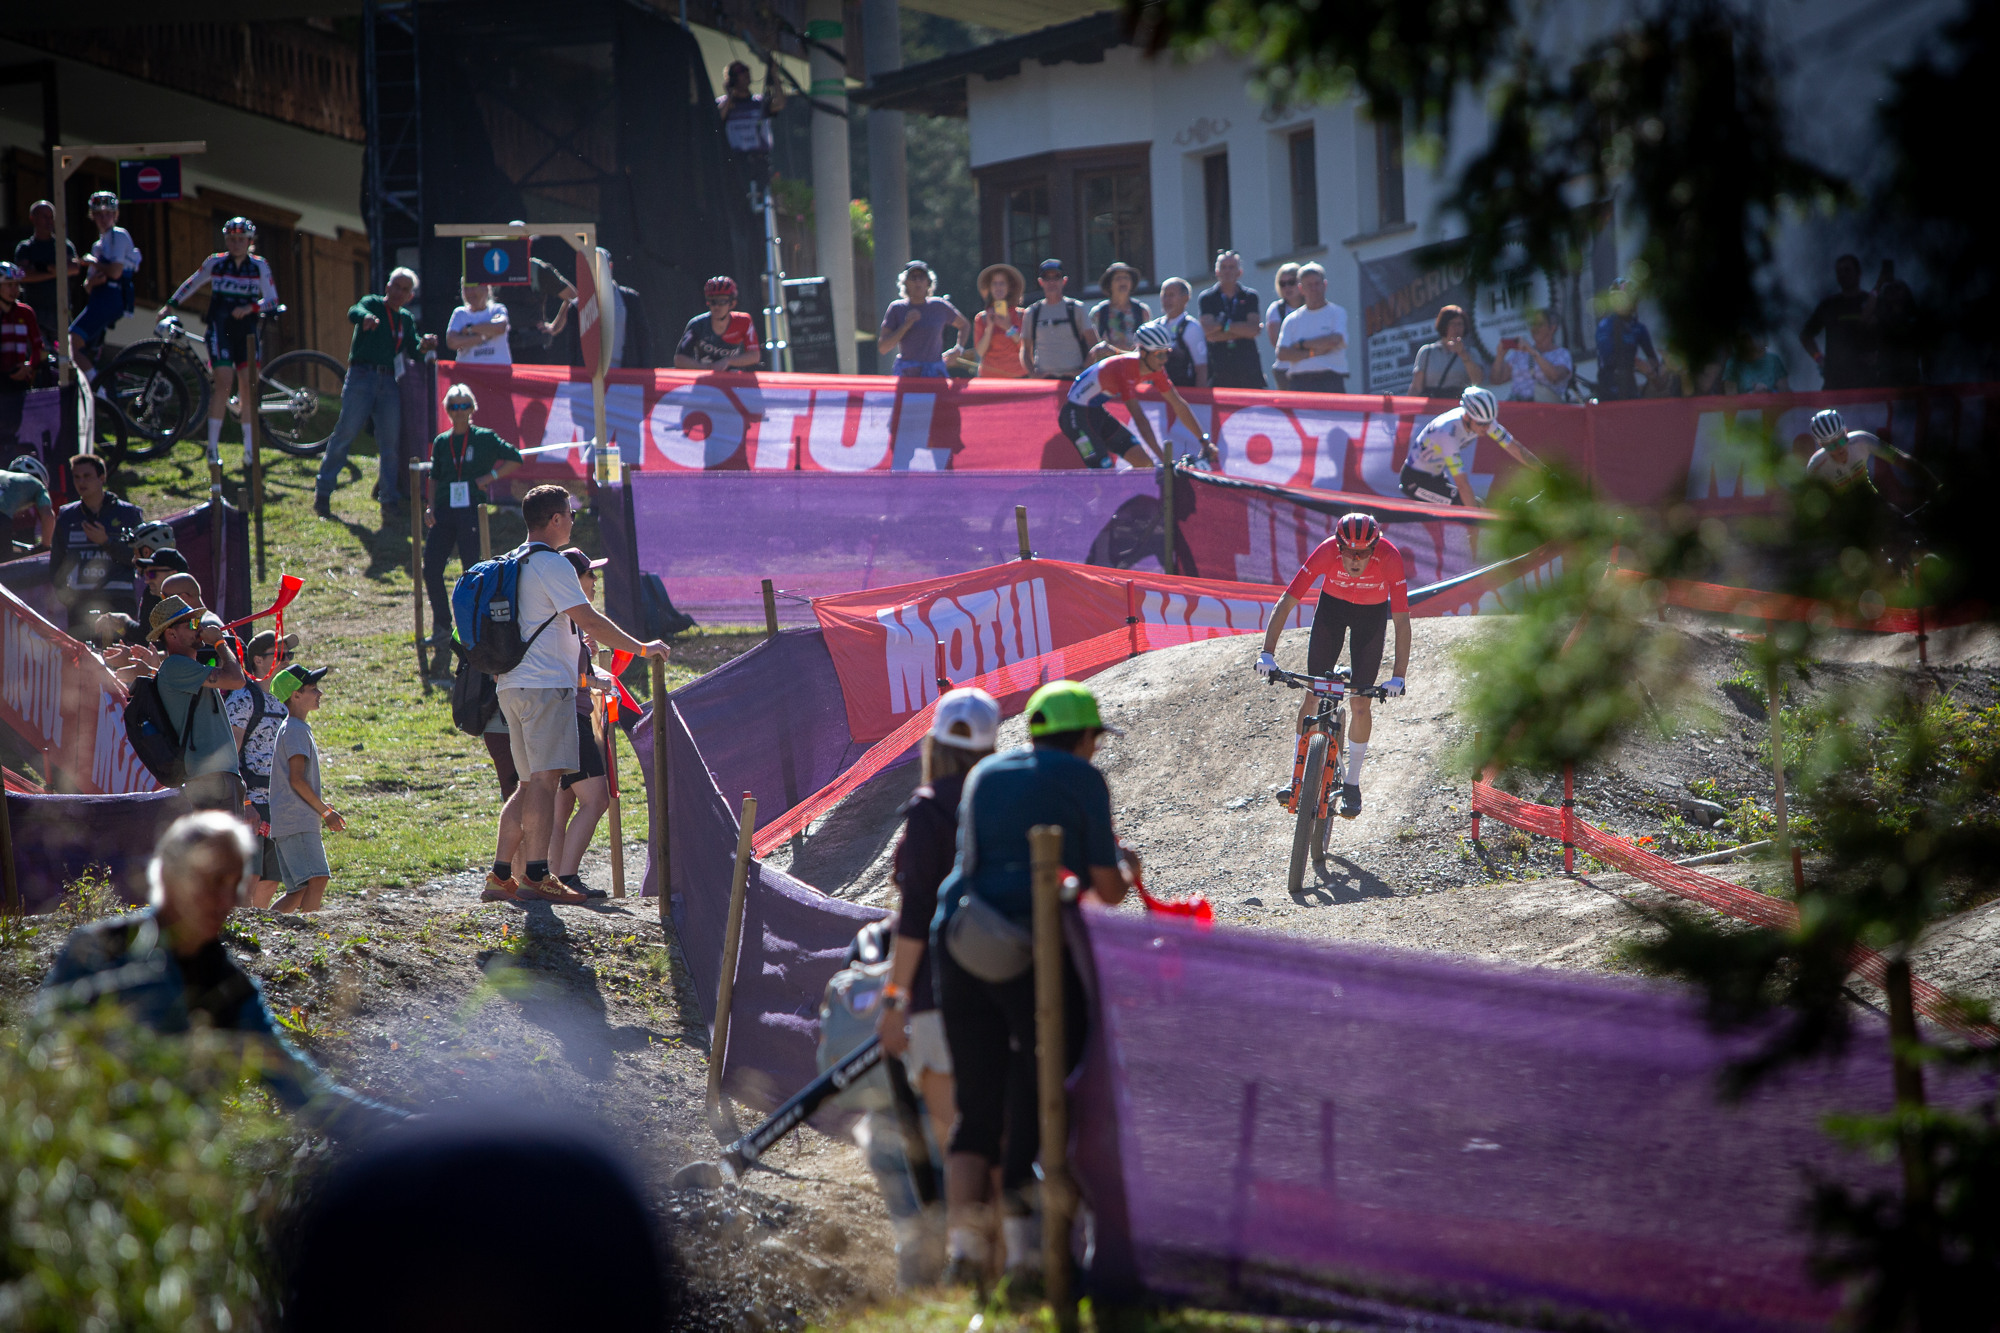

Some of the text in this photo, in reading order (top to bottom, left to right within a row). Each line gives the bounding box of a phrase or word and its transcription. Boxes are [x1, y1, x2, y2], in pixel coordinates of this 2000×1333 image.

[536, 381, 951, 472] MOTUL
[3, 608, 63, 748] MOTUL
[877, 577, 1065, 714] MOTUL
[1325, 683, 1332, 692] 1
[540, 884, 562, 896] HOKA
